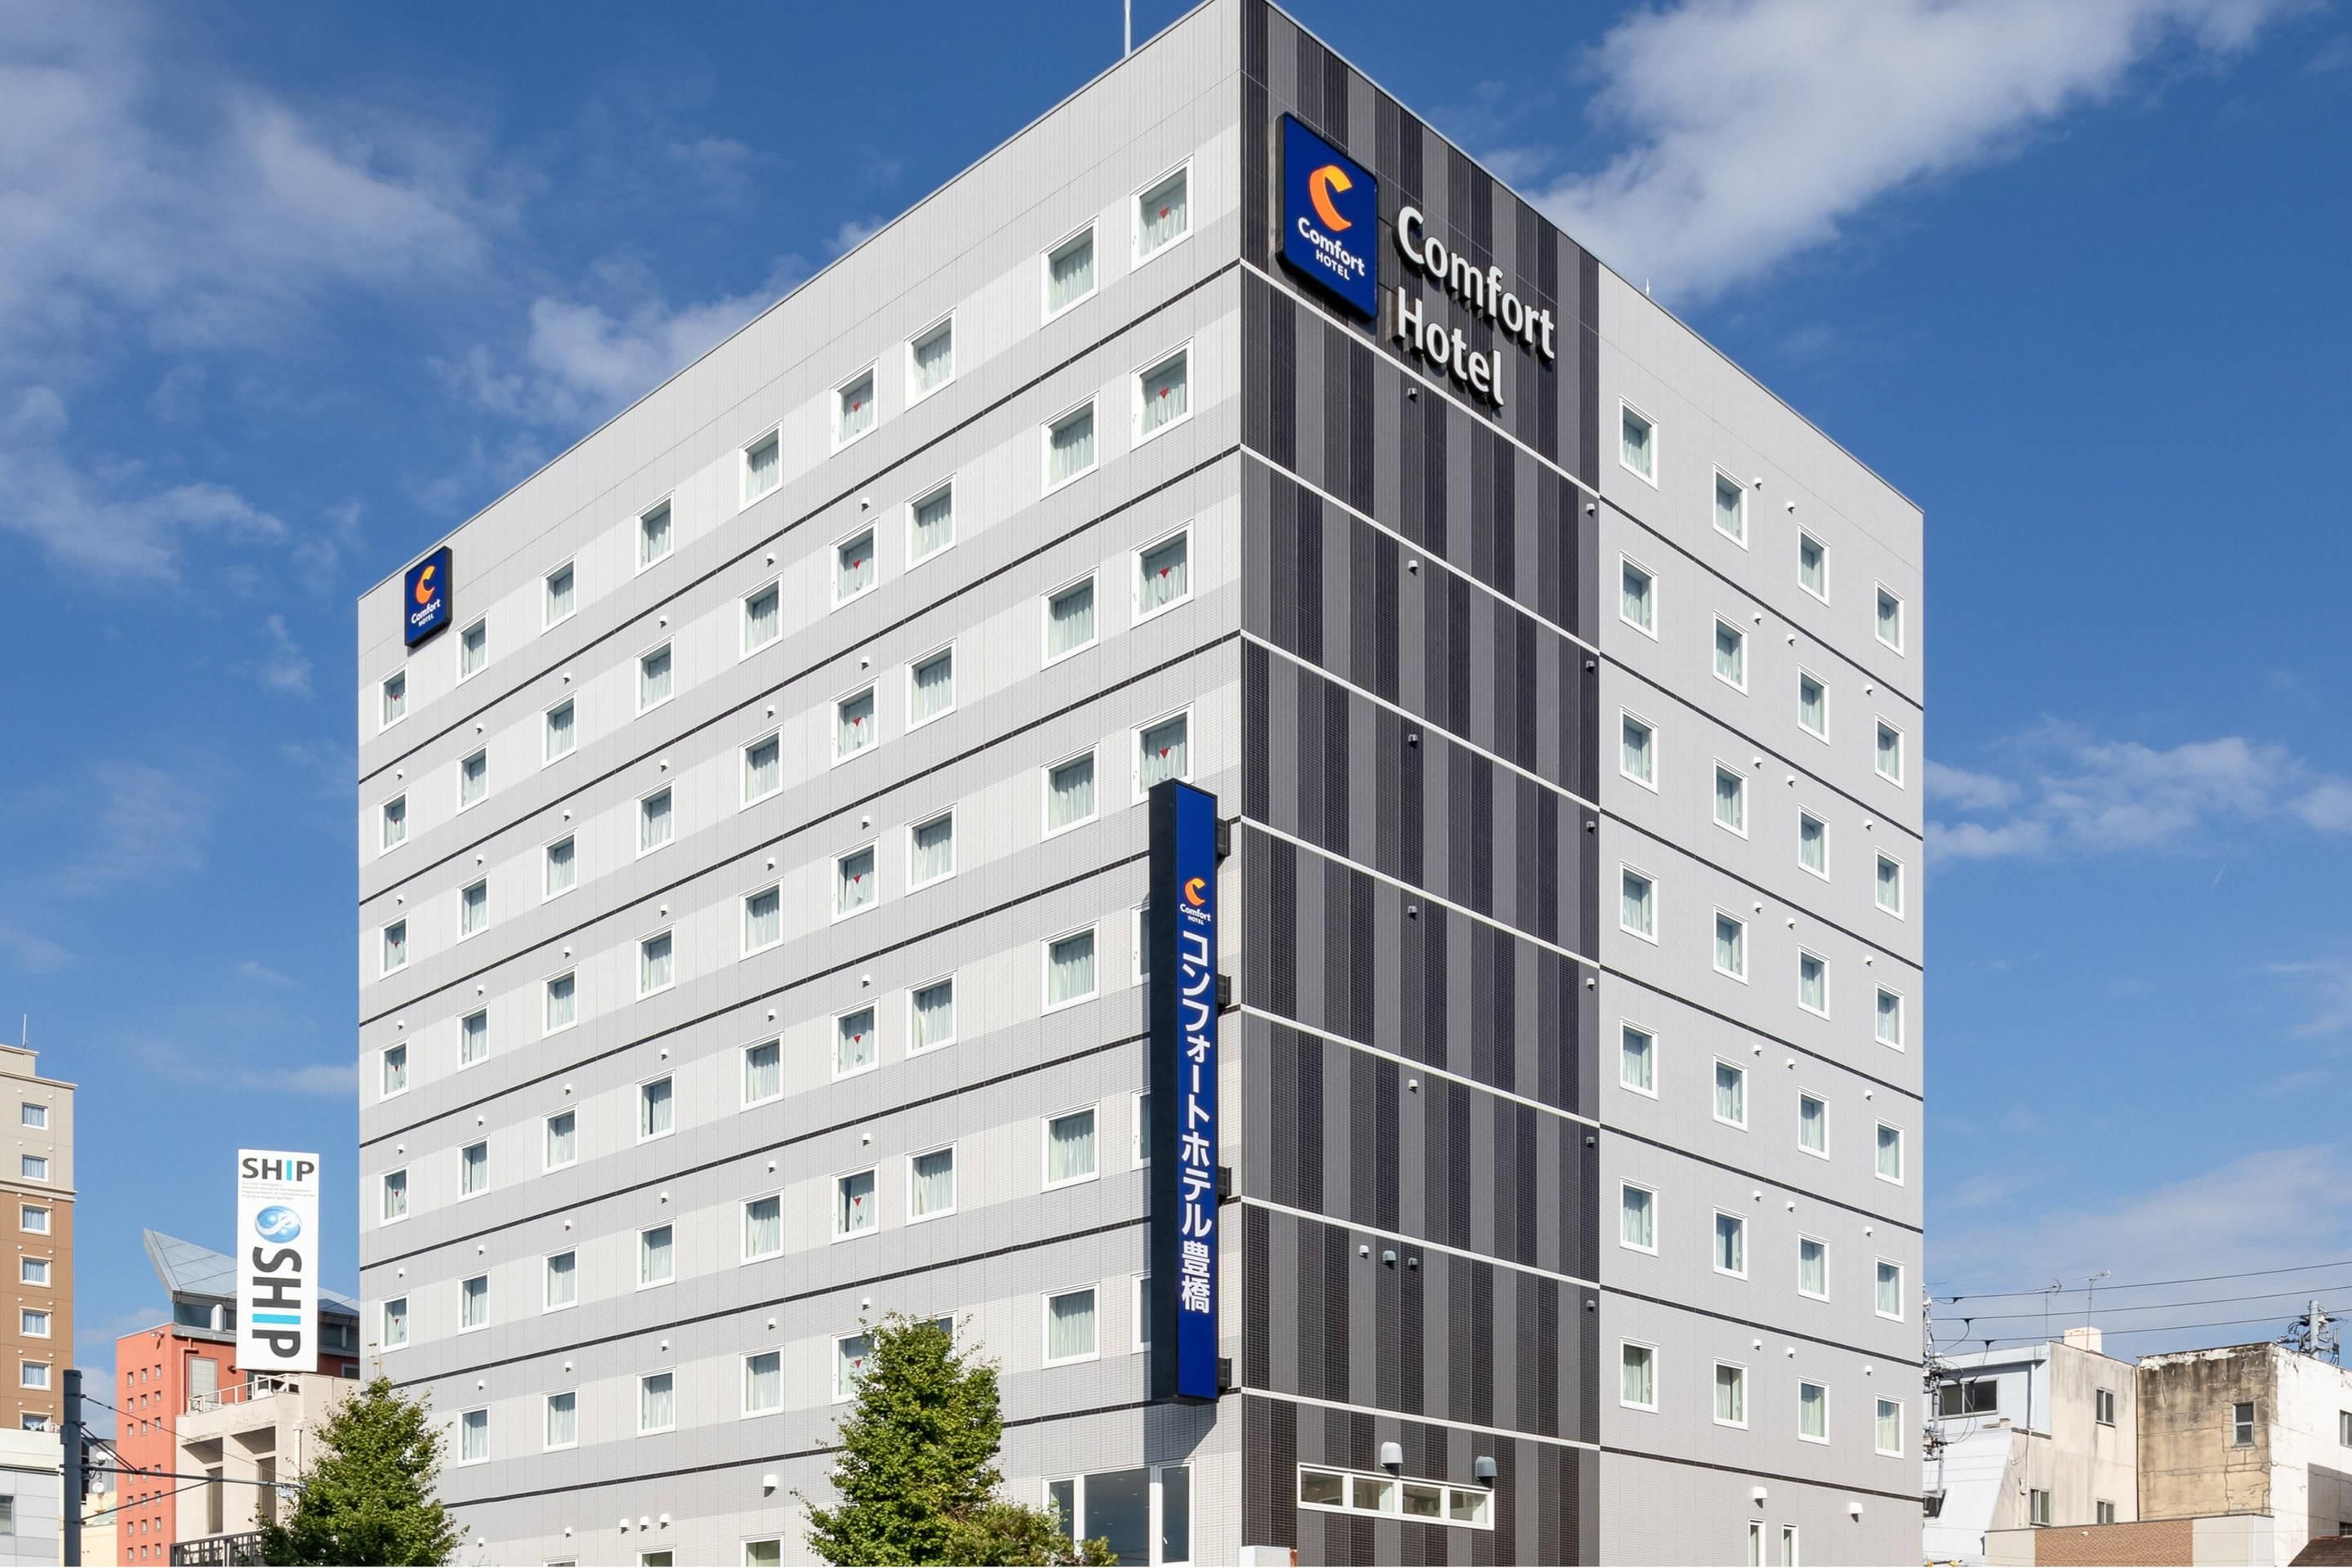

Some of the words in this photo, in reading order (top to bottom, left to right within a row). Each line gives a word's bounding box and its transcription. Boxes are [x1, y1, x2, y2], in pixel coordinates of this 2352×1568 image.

[1298, 216, 1365, 278] Comfort
[1316, 249, 1351, 281] HOTEL
[1397, 206, 1556, 360] Comfort
[1396, 286, 1504, 407] Hotel
[411, 599, 441, 624] Comfort
[418, 613, 434, 627] HOTEL
[1179, 903, 1211, 921] Comfort
[1187, 915, 1204, 925] HOTEL
[1182, 930, 1211, 1313] コンフォートホテル豊橋
[242, 1157, 315, 1182] SHIP
[252, 1246, 302, 1359] SHIP
